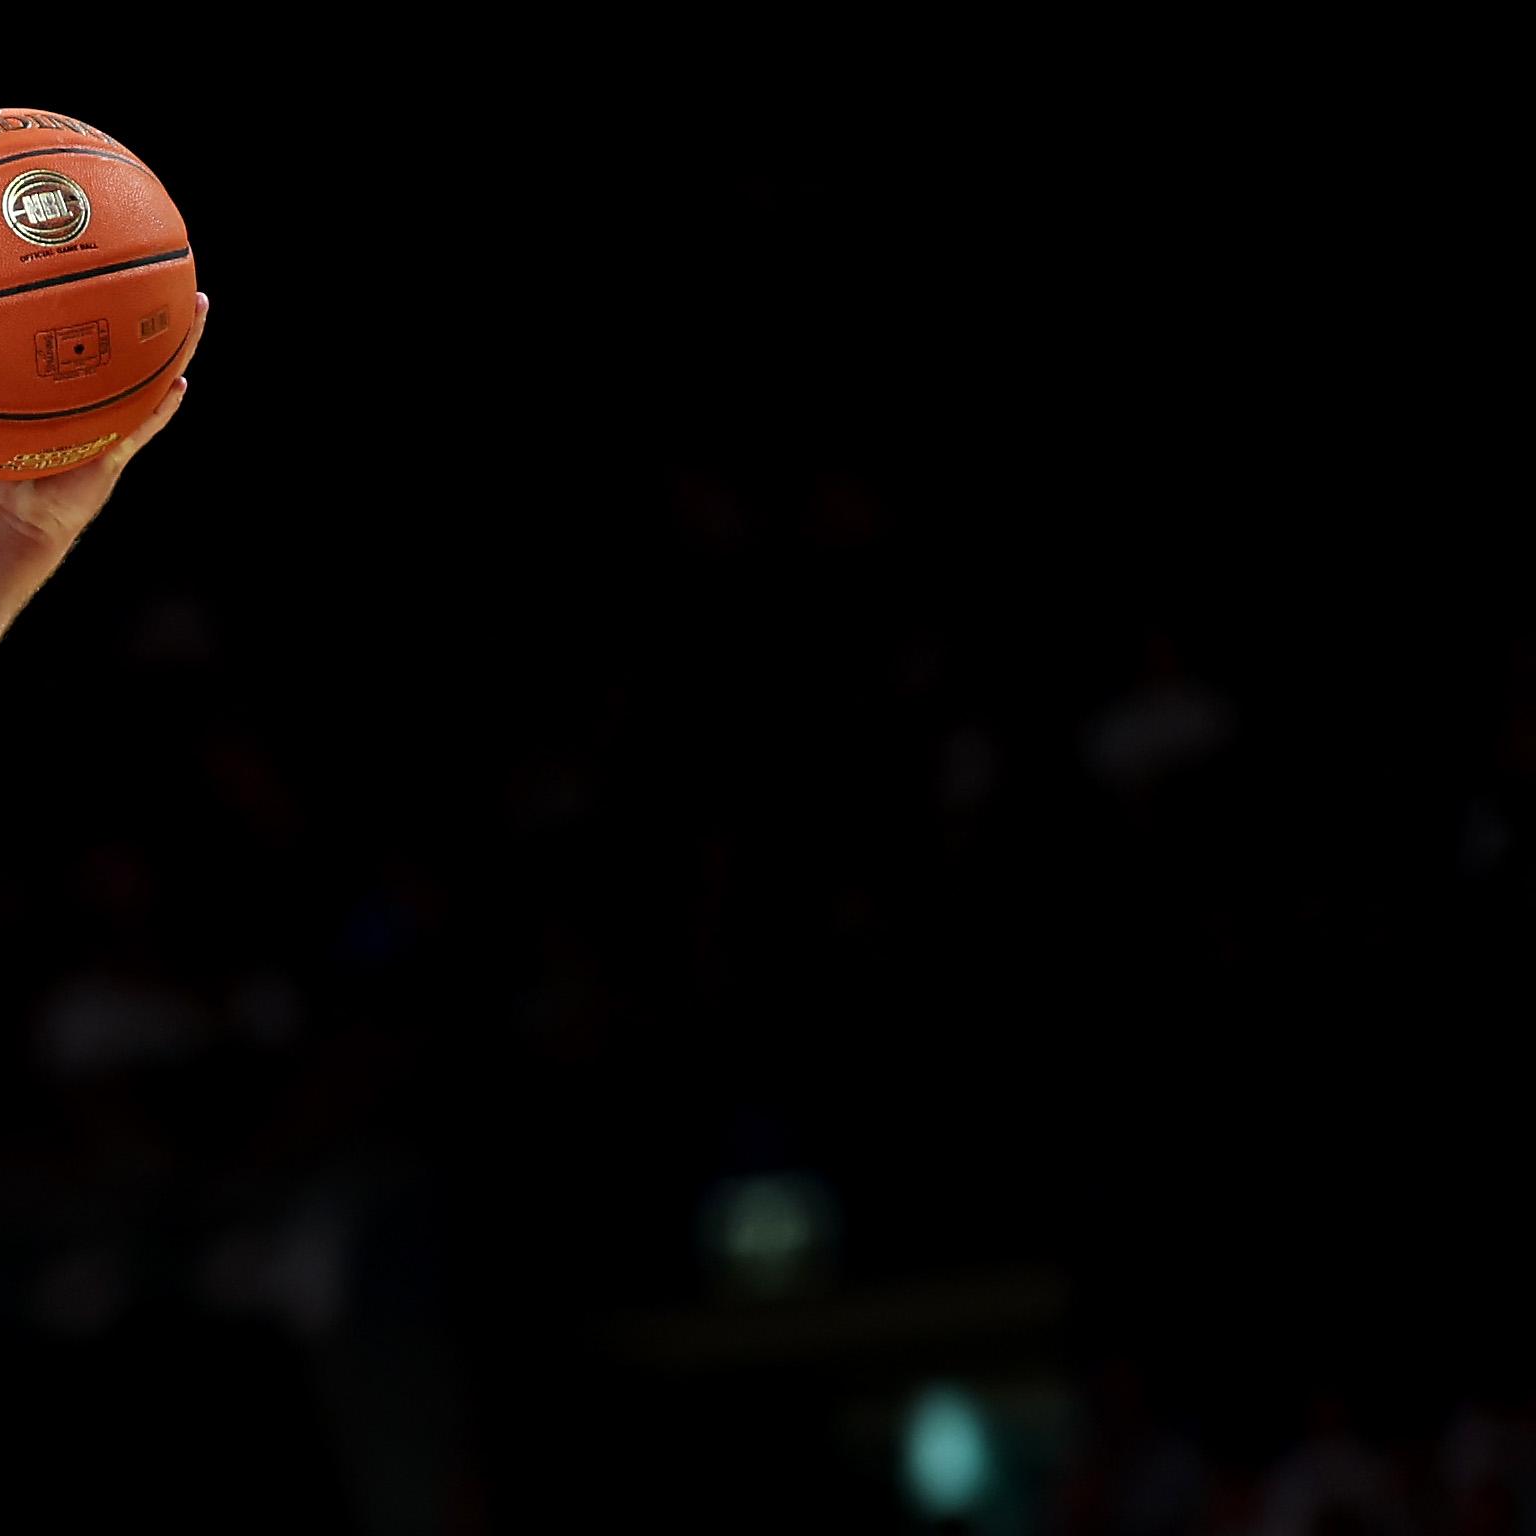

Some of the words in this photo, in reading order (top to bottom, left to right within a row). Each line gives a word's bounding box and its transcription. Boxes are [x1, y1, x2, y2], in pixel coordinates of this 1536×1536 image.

[22, 189, 73, 224] NBL
[19, 248, 55, 263] OFFICIAL
[57, 245, 78, 255] GAME
